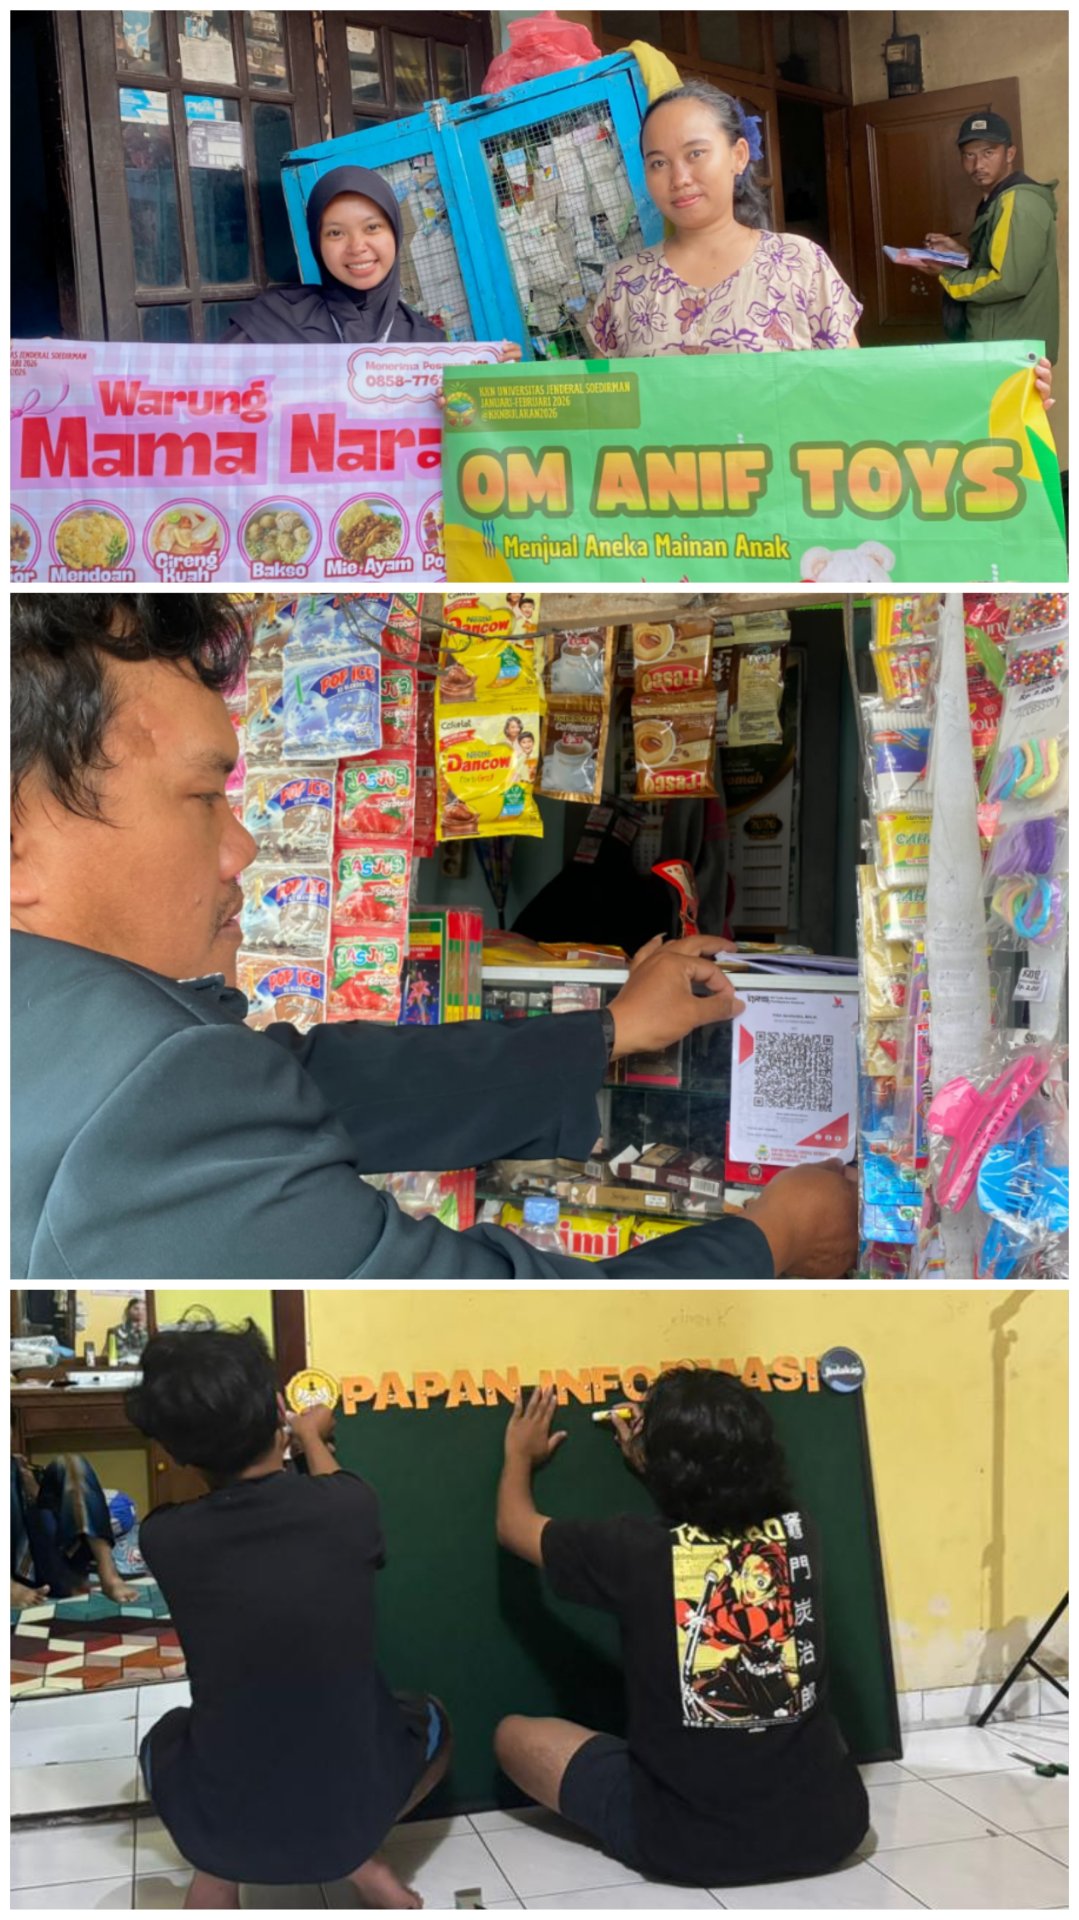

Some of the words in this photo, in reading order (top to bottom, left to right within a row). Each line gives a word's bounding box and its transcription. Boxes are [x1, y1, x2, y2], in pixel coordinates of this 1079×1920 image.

[365, 374, 442, 387] 0858-776
[497, 384, 545, 396] UNIVERSITAS
[546, 382, 585, 395] JENDERAL
[585, 381, 631, 394] SOEDIRMAN
[98, 378, 268, 424] Warung
[20, 416, 257, 479] Mama
[289, 412, 442, 475] Nara
[460, 451, 573, 515] OM
[596, 450, 767, 512] ANIF
[797, 446, 1020, 514] TOYS
[503, 534, 579, 565] Menjual
[585, 532, 649, 559] Aneka
[653, 531, 727, 558] Mainan
[734, 532, 791, 559] Anak
[156, 551, 218, 570] Cireng
[252, 561, 307, 577] Bakso
[326, 560, 357, 575] Mie
[364, 557, 412, 577] Ayam
[51, 566, 133, 582] Mendoan
[163, 569, 209, 582] Kuah
[320, 668, 349, 695] POP
[447, 753, 511, 772] Dancow
[268, 970, 293, 990] POP
[297, 969, 320, 989] ICE
[340, 1366, 522, 1416] PAPAN
[539, 1356, 820, 1407] INFOASI
